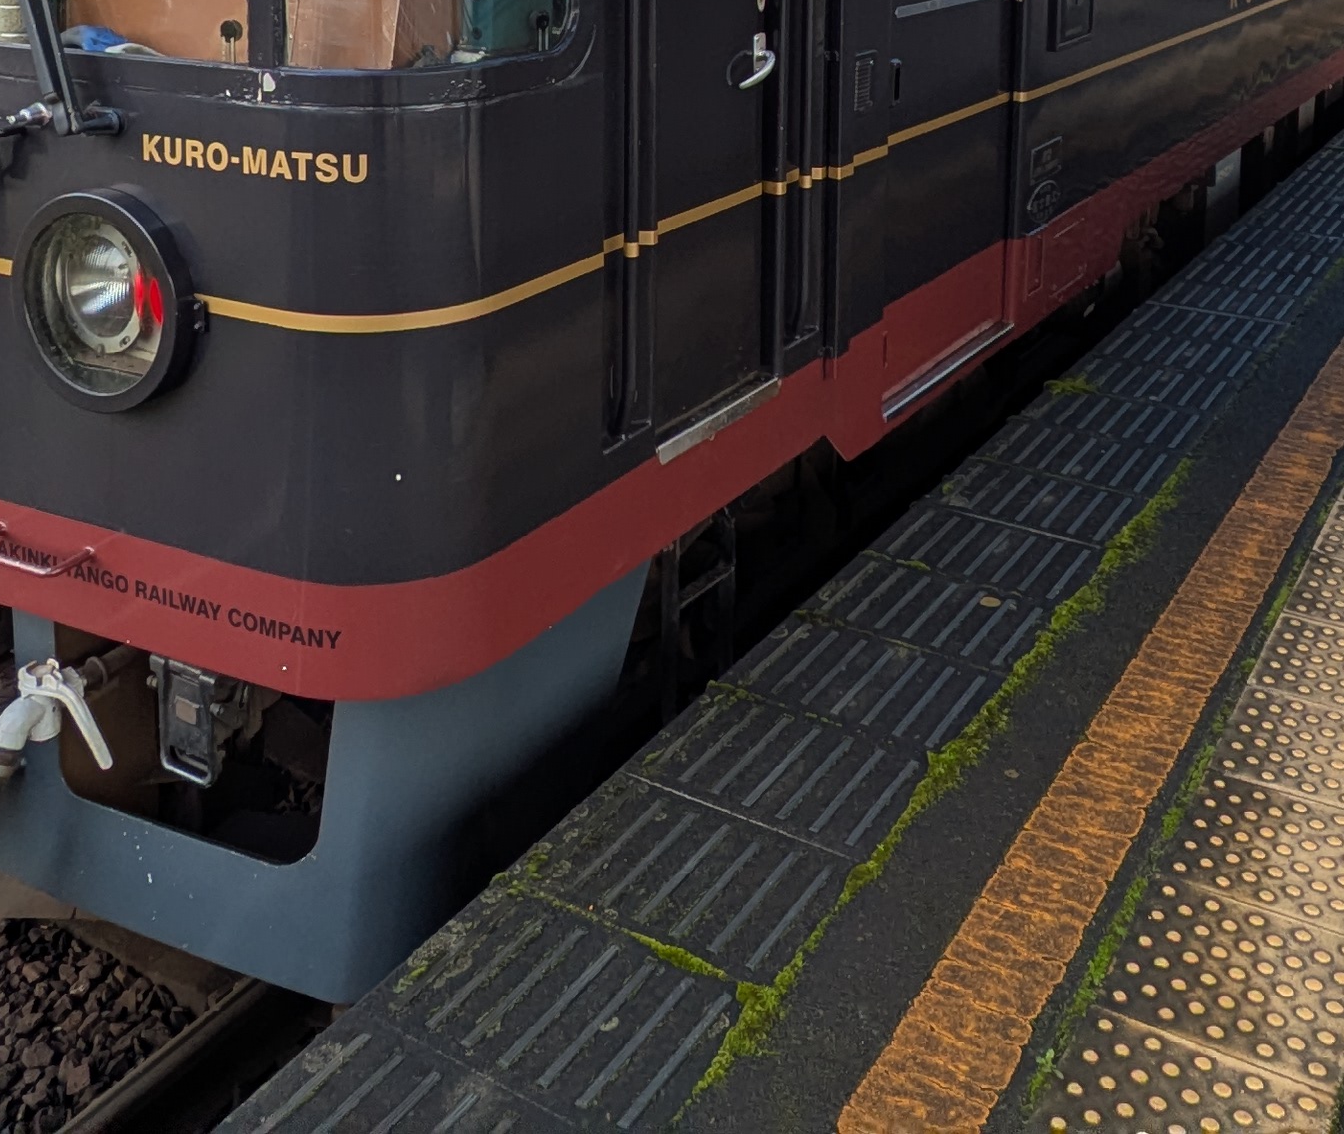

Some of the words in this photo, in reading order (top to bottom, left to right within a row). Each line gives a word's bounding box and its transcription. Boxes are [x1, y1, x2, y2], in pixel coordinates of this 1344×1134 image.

[142, 133, 369, 184] KURO-MATSU
[134, 579, 222, 623] RAILWAY
[226, 607, 343, 650] COMPANY
